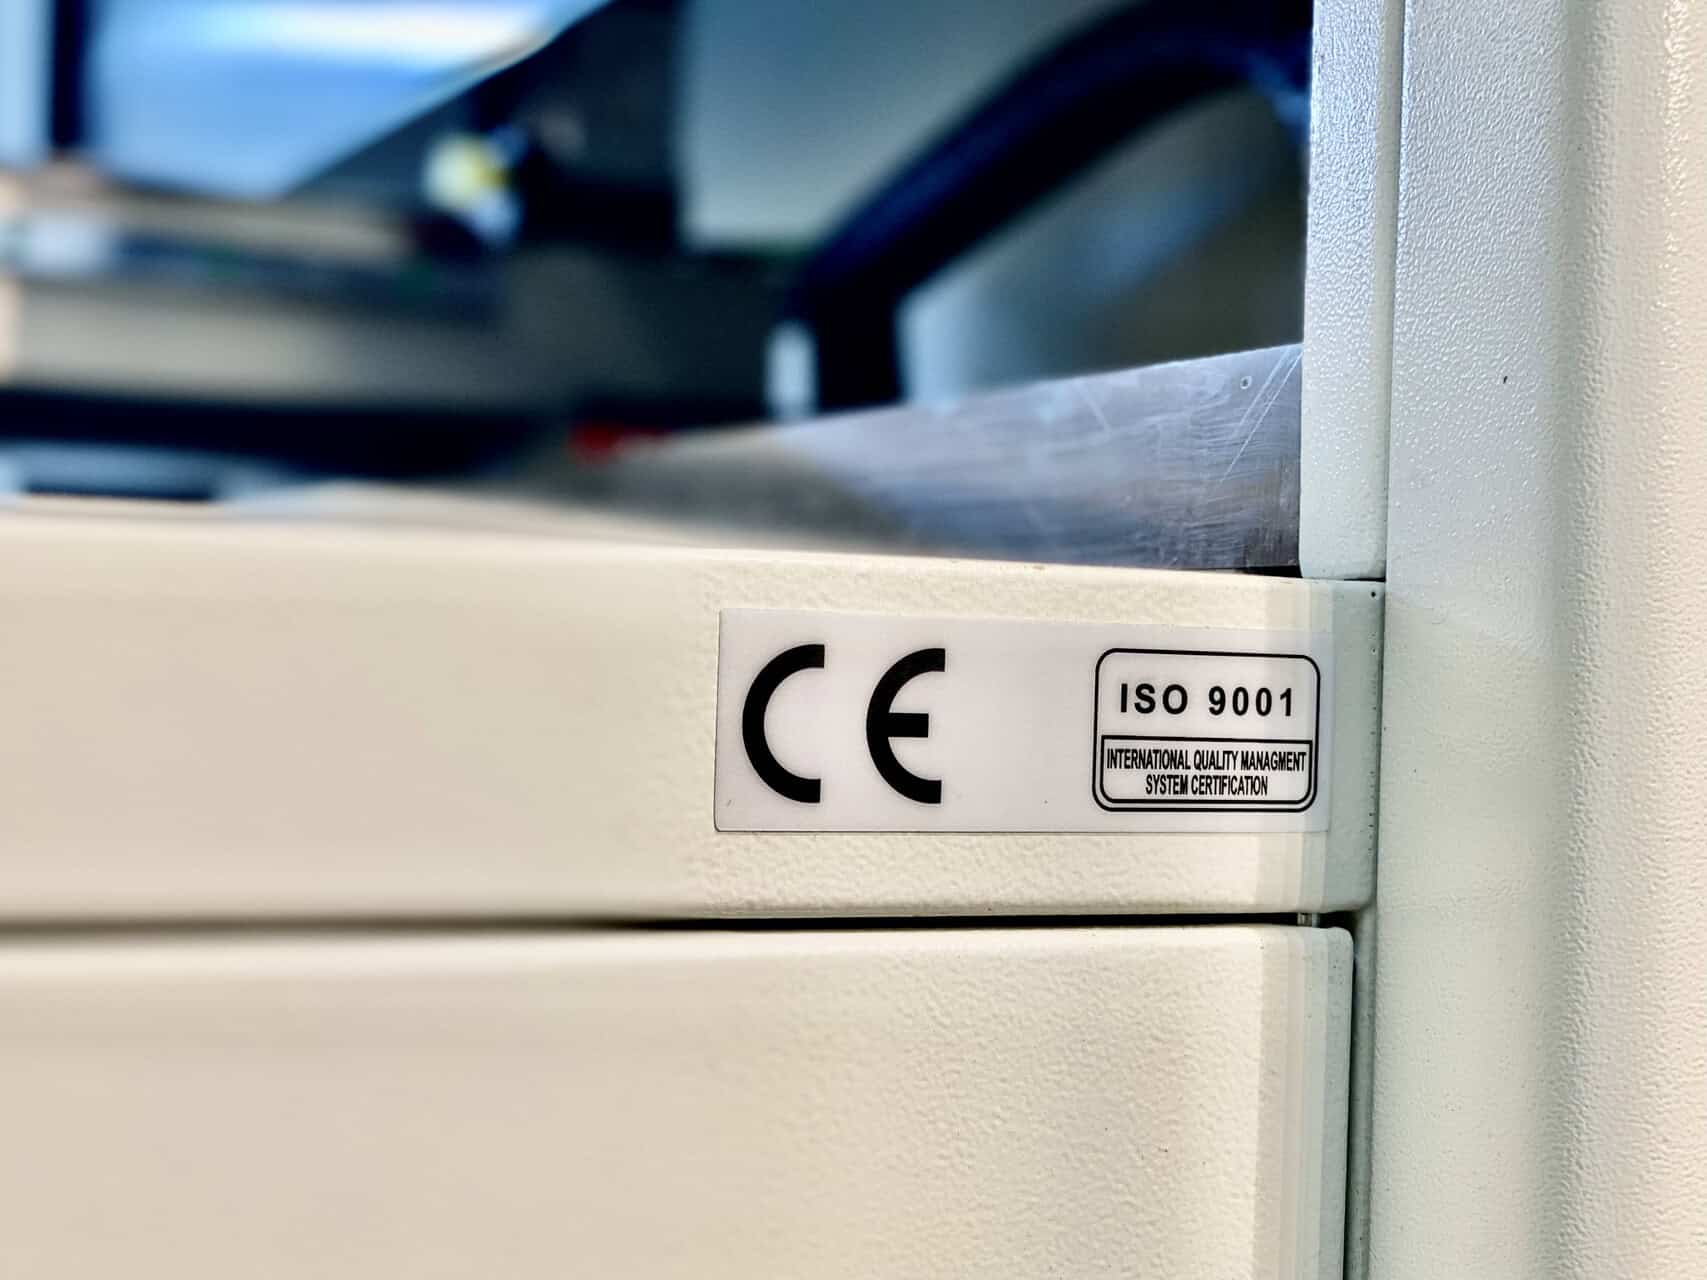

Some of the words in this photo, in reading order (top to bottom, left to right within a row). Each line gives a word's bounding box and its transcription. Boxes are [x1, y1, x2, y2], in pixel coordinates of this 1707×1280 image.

[1120, 683, 1188, 714] ISO
[1208, 686, 1292, 717] 9001
[742, 644, 946, 804] CE
[1106, 748, 1191, 770] INTERNATIONAL
[1193, 750, 1239, 771] QUALITY
[1240, 751, 1307, 772] MANAGMENT
[1145, 774, 1188, 796] SYSTEM
[1191, 775, 1268, 796] CERTIFICATION
